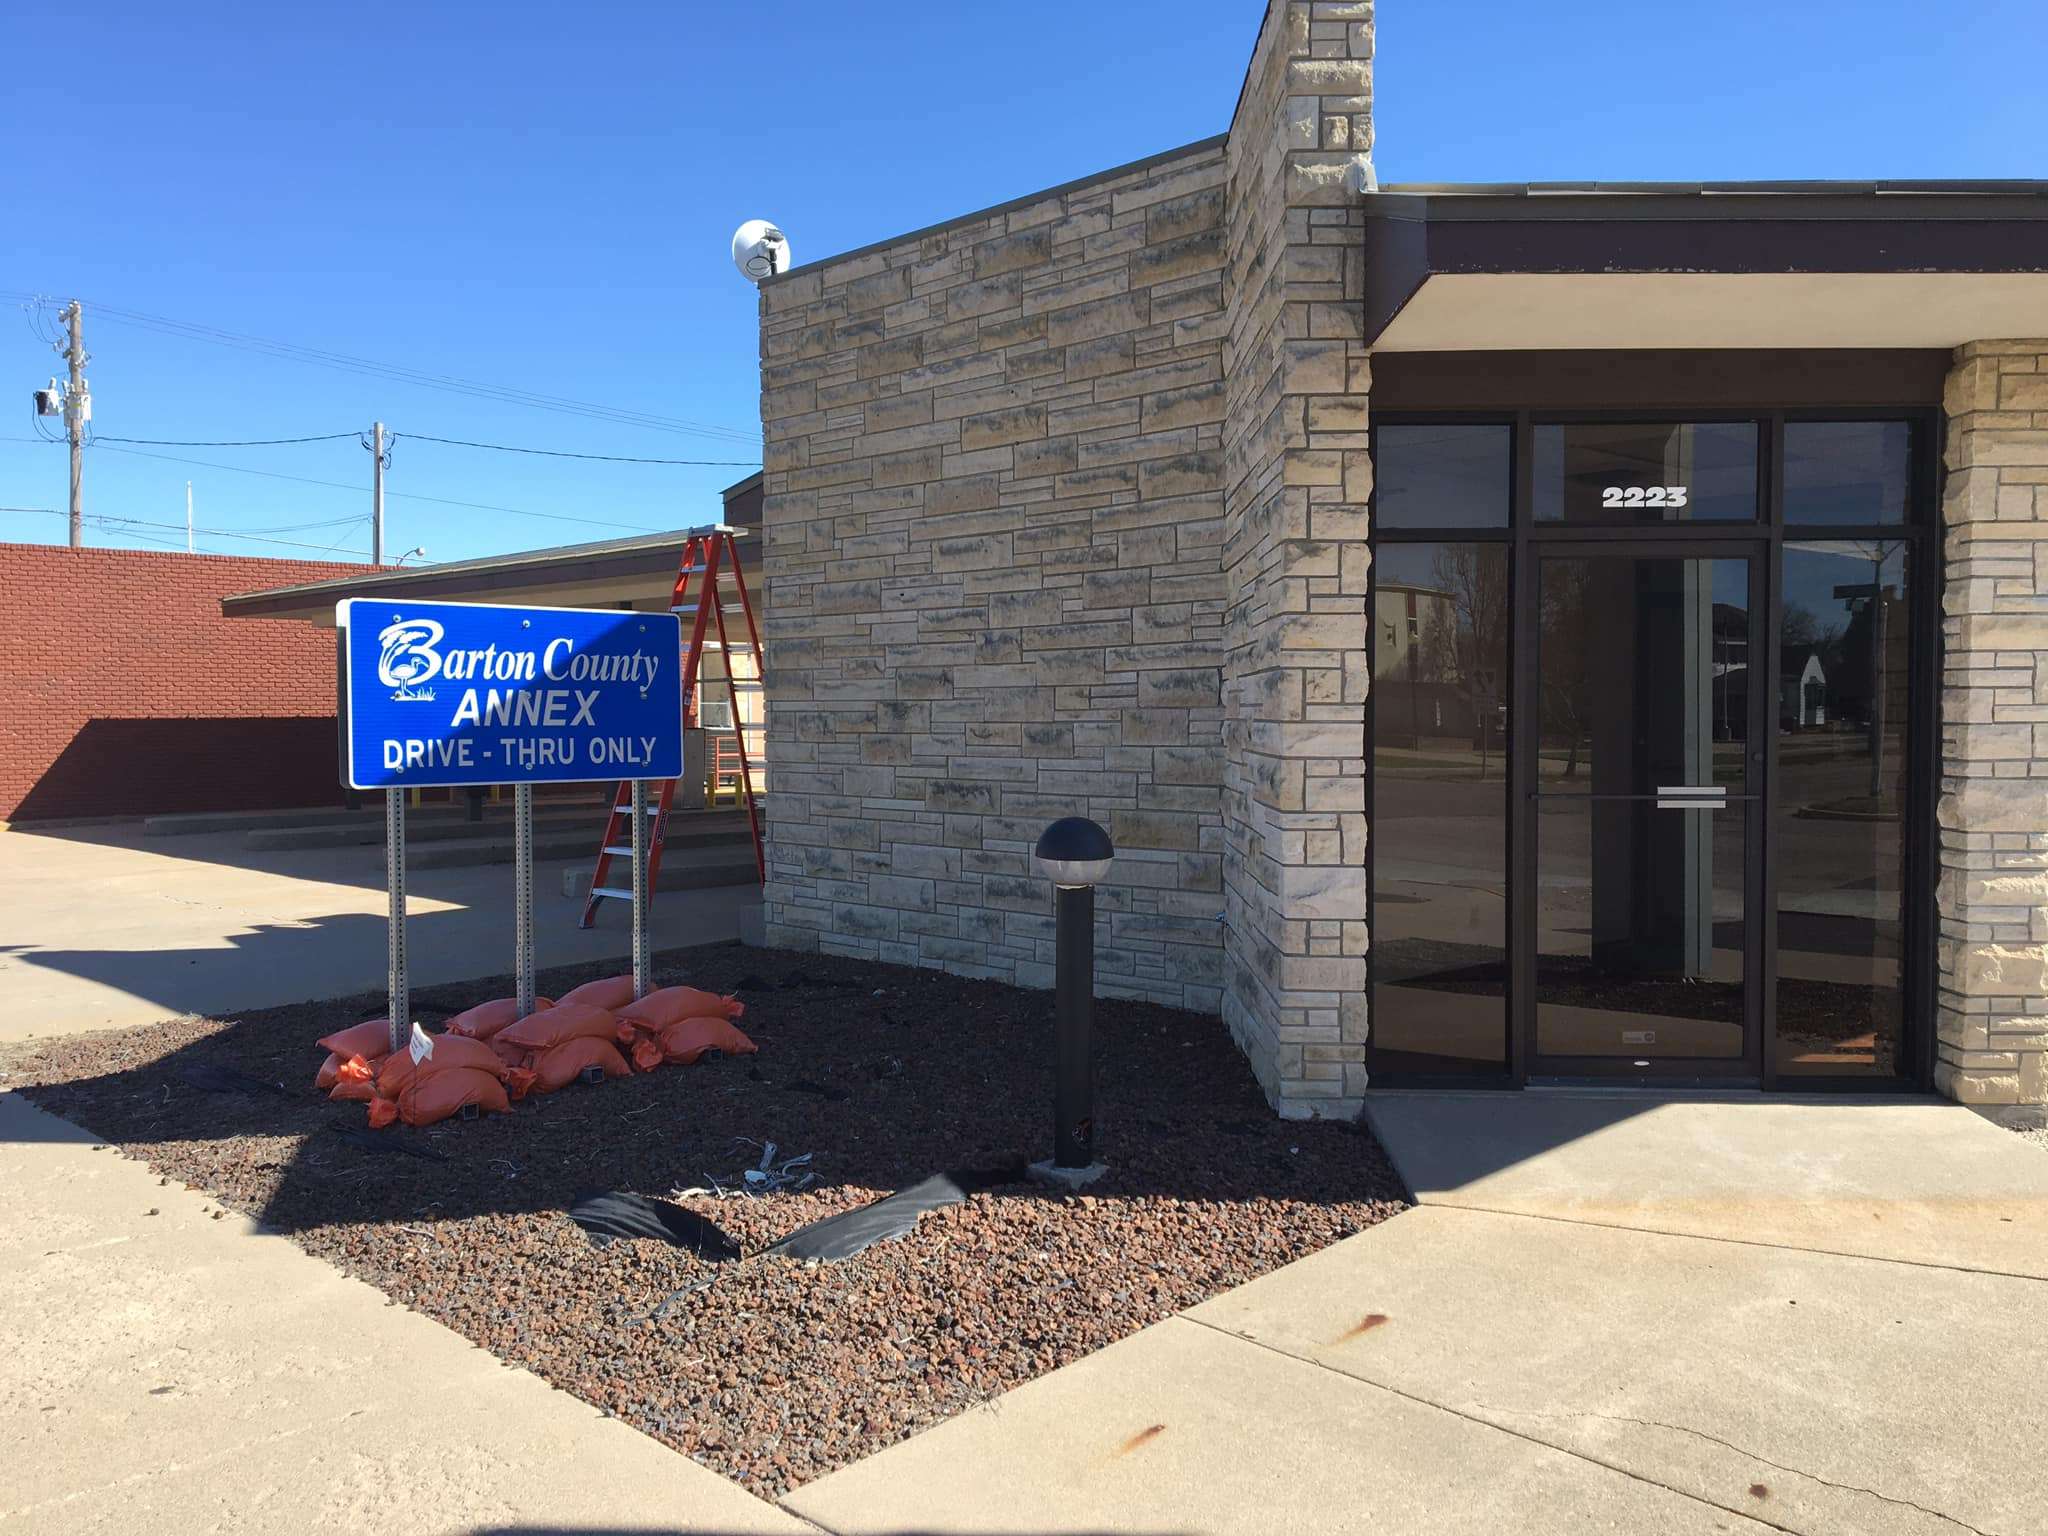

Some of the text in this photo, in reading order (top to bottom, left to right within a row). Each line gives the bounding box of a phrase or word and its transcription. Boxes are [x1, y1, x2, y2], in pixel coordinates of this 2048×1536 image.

[1602, 486, 1688, 508] 2223
[378, 618, 659, 693] Barton County
[450, 688, 600, 727] ANNEX
[383, 738, 474, 769] DRIVE
[500, 737, 575, 766] THRU
[588, 736, 657, 764] ONLY
